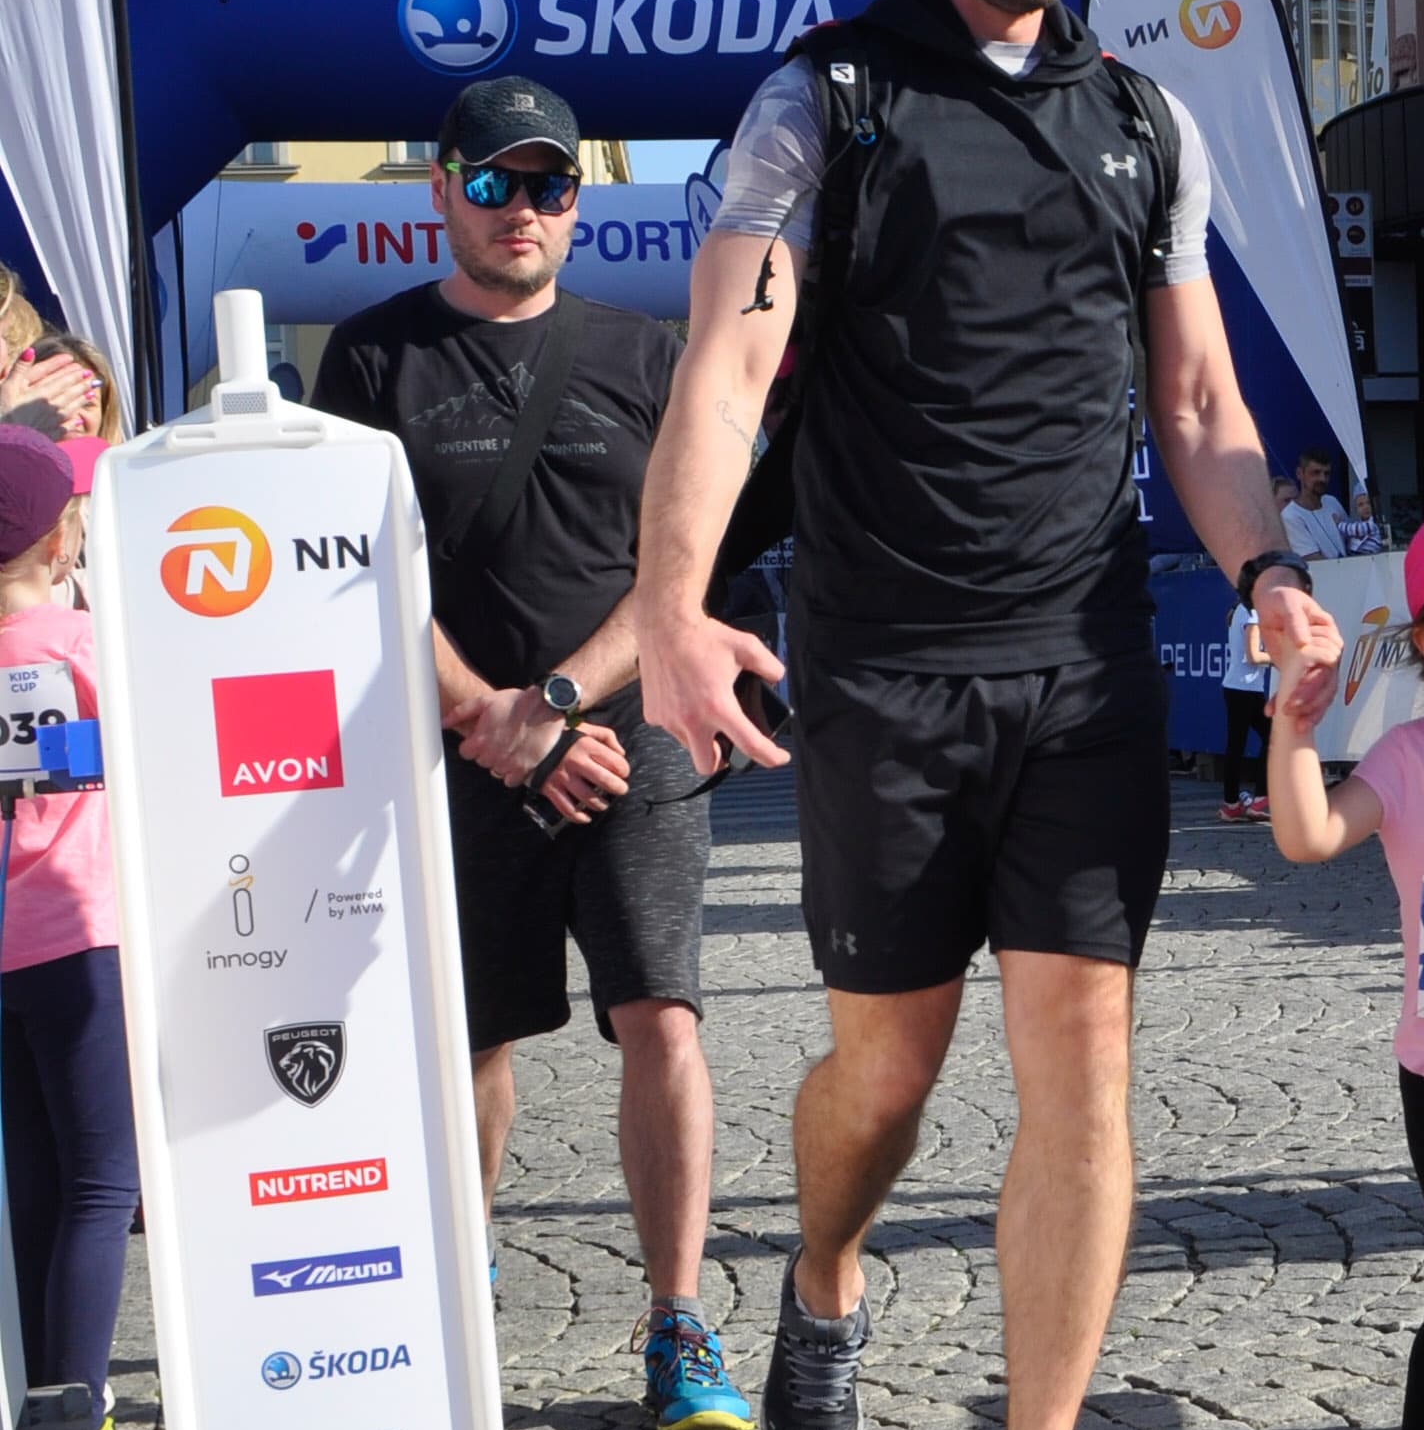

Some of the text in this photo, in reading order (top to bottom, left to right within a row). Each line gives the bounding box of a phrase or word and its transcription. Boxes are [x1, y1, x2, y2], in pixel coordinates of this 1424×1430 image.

[357, 220, 695, 265] INTPORT
[293, 534, 371, 571] NN
[1161, 643, 1232, 677] PEUGE
[9, 670, 39, 682] KIDS
[11, 682, 37, 693] CUP
[233, 756, 329, 786] AVON
[328, 889, 383, 903] Powered
[329, 903, 384, 919] by MVM
[206, 949, 288, 969] innogy
[272, 1028, 339, 1042] PEUGEOT
[257, 1166, 382, 1198] NUTREND
[308, 1344, 412, 1379] ŠKODA
